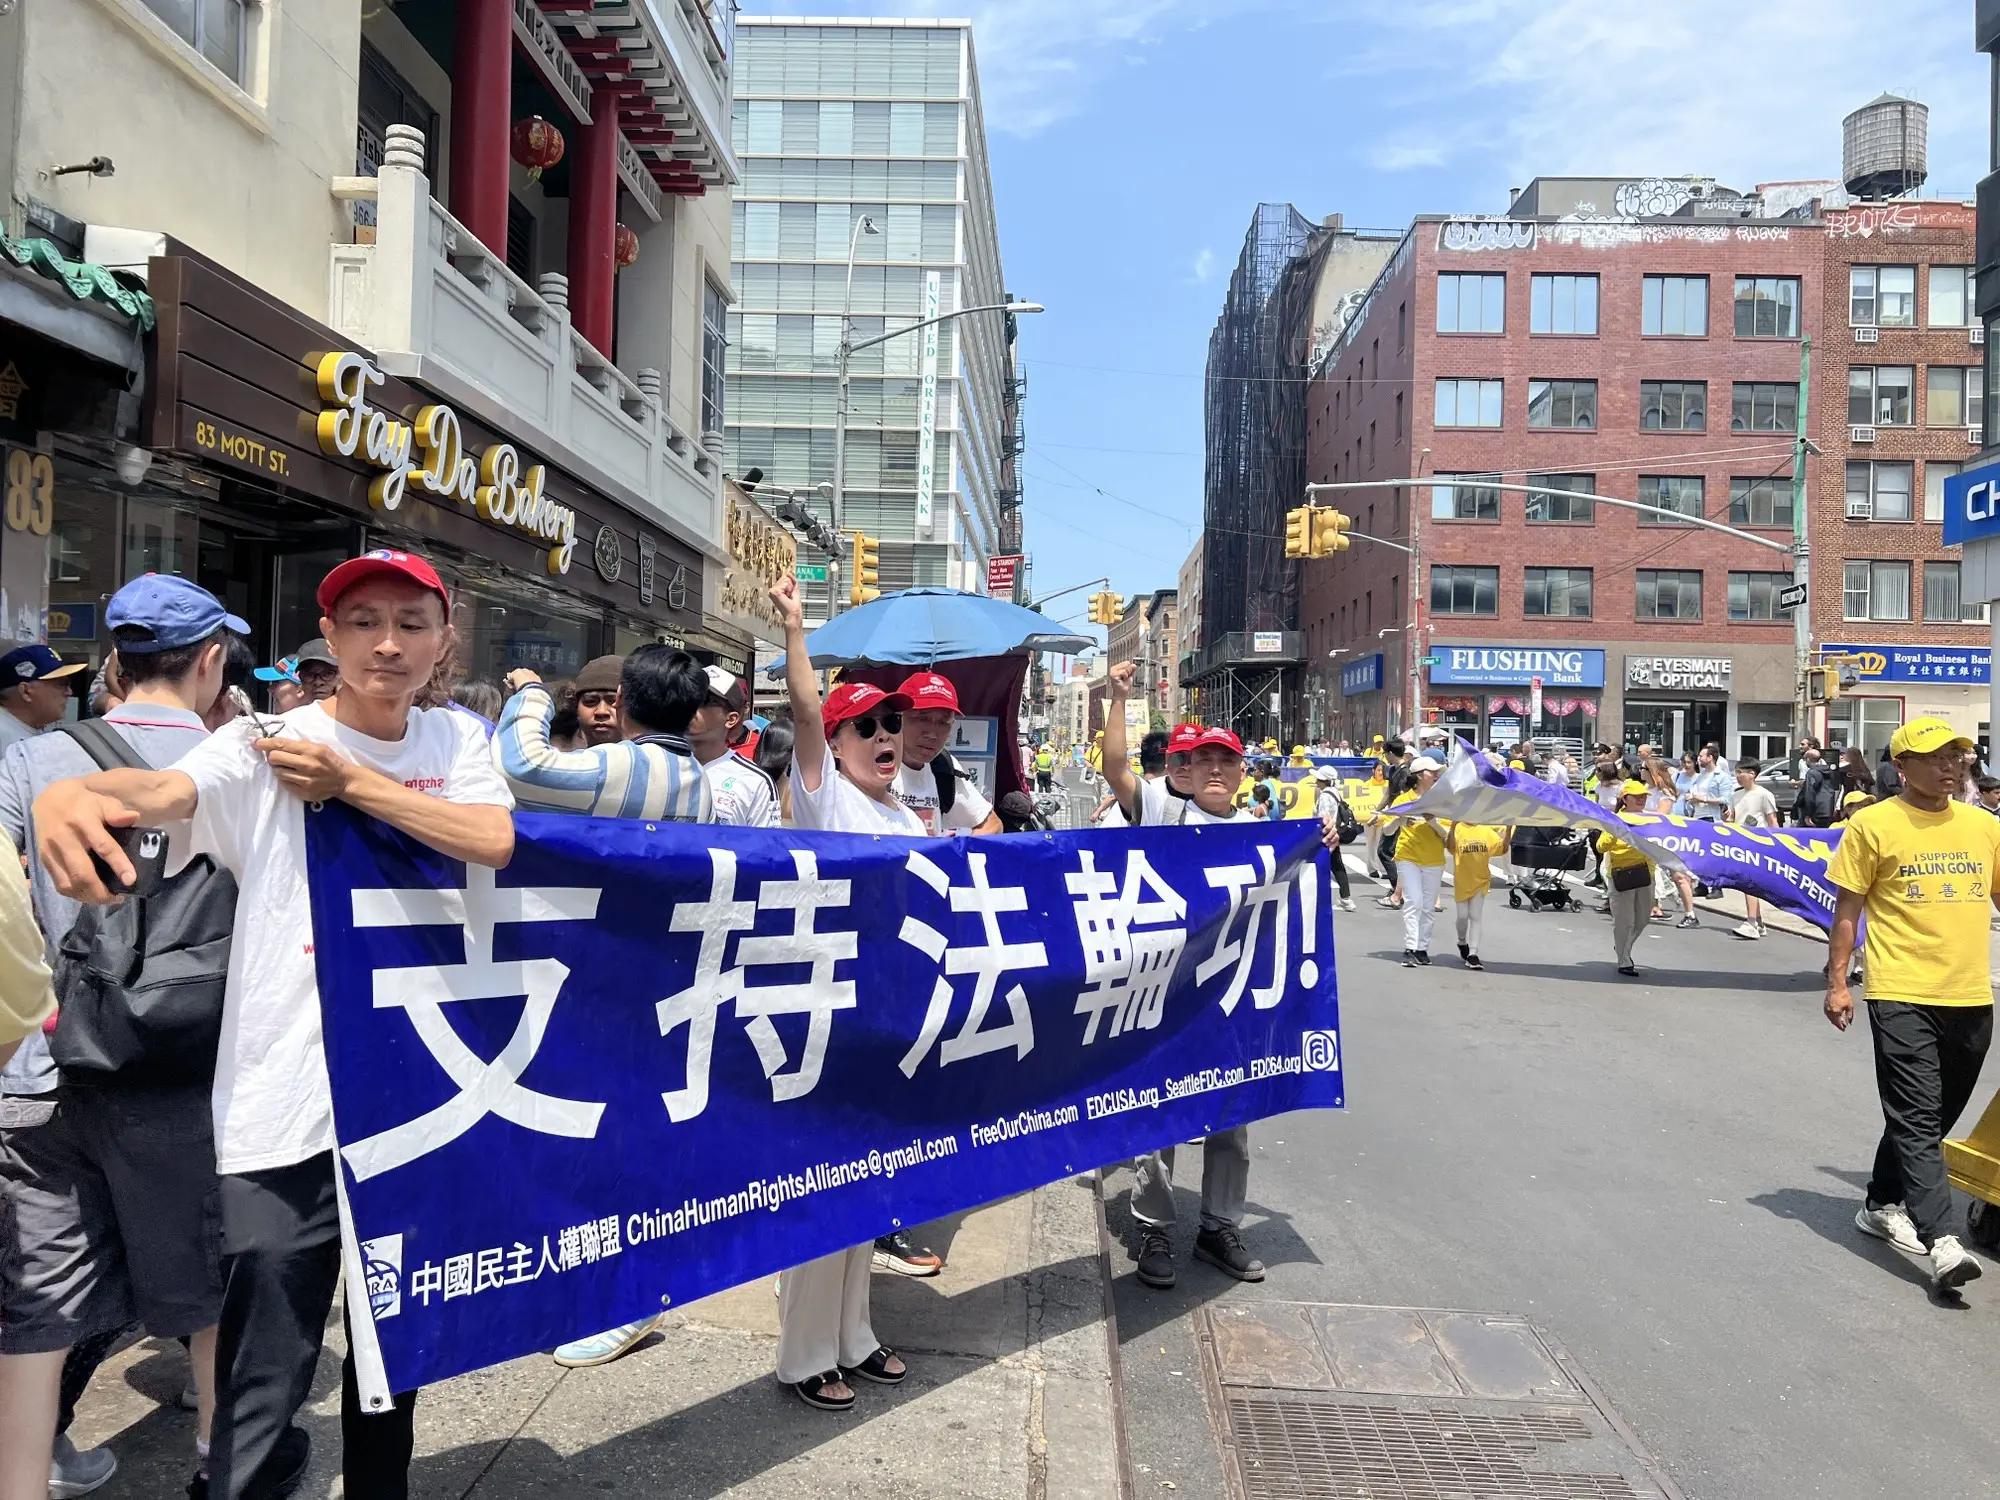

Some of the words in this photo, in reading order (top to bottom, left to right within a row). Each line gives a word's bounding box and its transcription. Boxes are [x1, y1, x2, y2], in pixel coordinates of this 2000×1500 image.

[923, 374, 934, 450] ORIENT
[195, 421, 215, 449] 83
[220, 430, 265, 466] MOTT
[269, 448, 290, 477] ST.
[318, 352, 416, 511] Fay
[408, 405, 477, 504] Da
[476, 444, 578, 575] Bakery
[6, 449, 53, 536] 83
[920, 465, 930, 514] BANK
[1451, 649, 1583, 673] FLUSHING
[1553, 672, 1583, 683] Bank
[1653, 658, 1732, 674] EYESMATE
[1660, 673, 1724, 688] OPTICAL
[1894, 653, 1921, 664] Royal
[1925, 653, 1967, 664] Business
[1710, 842, 1760, 867] SIGN
[1764, 855, 1800, 886] THE
[1900, 863, 1946, 877] FALUN
[1920, 852, 1969, 861] SUPPORT
[626, 1133, 959, 1247] ChinaHumanRightsAlliance@gmail.com
[970, 1106, 1079, 1148] FreeOurChina.com
[1086, 1085, 1160, 1119] FDCUSA.org
[1165, 1065, 1244, 1099] SeattleFDC.com
[1250, 1054, 1301, 1081] FDC64.org
[411, 1214, 623, 1307] 中國民主人權聯盟
